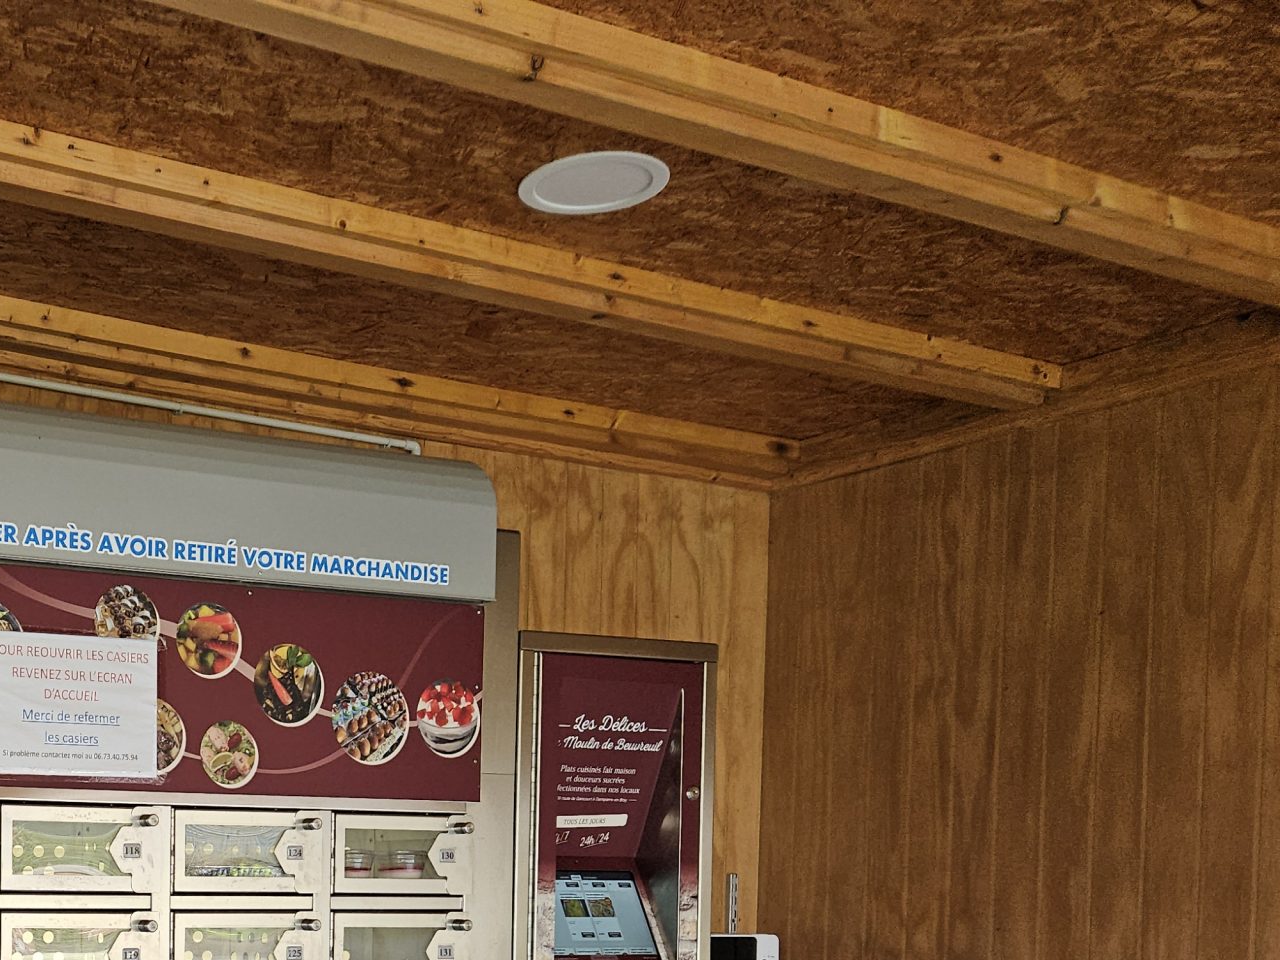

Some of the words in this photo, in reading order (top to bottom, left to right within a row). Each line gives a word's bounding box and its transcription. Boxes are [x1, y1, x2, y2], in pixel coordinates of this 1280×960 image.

[26, 524, 91, 551] APRÈS
[100, 535, 165, 556] AVOIR
[175, 541, 236, 564] RETIRÉ
[245, 549, 304, 571] VOTRE
[312, 556, 448, 584] MARCHANDISE
[26, 646, 83, 660] REOUVRIR
[86, 650, 104, 661] LES
[106, 651, 149, 664] CASIERS
[12, 666, 62, 681] REVENEZ
[64, 669, 86, 682] SUR
[89, 671, 133, 684] L'ECRAN
[44, 688, 99, 702] D'ACCUEIL
[22, 709, 54, 721] Merci
[57, 710, 70, 722] de
[74, 711, 120, 724] refermer
[573, 714, 597, 733] Les
[599, 715, 648, 733] Délices
[44, 730, 60, 743] les
[62, 733, 99, 744] casiers
[563, 736, 600, 750] Moulin
[601, 739, 614, 750] de
[2, 749, 9, 757] Si
[9, 750, 40, 759] problème
[72, 752, 84, 760] moi
[93, 753, 138, 761] 06.73.40.75.94
[560, 764, 576, 773] Plats
[576, 765, 601, 774] cuisinés
[602, 765, 613, 774] fait
[614, 767, 636, 775] maison
[573, 775, 602, 784] douceurs
[602, 776, 626, 785] sucrées
[592, 784, 607, 793] dans
[608, 786, 619, 794] nos
[620, 785, 640, 794] locaux
[125, 846, 140, 855] 118
[288, 848, 303, 858] 124
[441, 852, 455, 860] 130
[123, 951, 139, 960] 119
[287, 949, 302, 959] 125
[439, 948, 453, 957] 131
